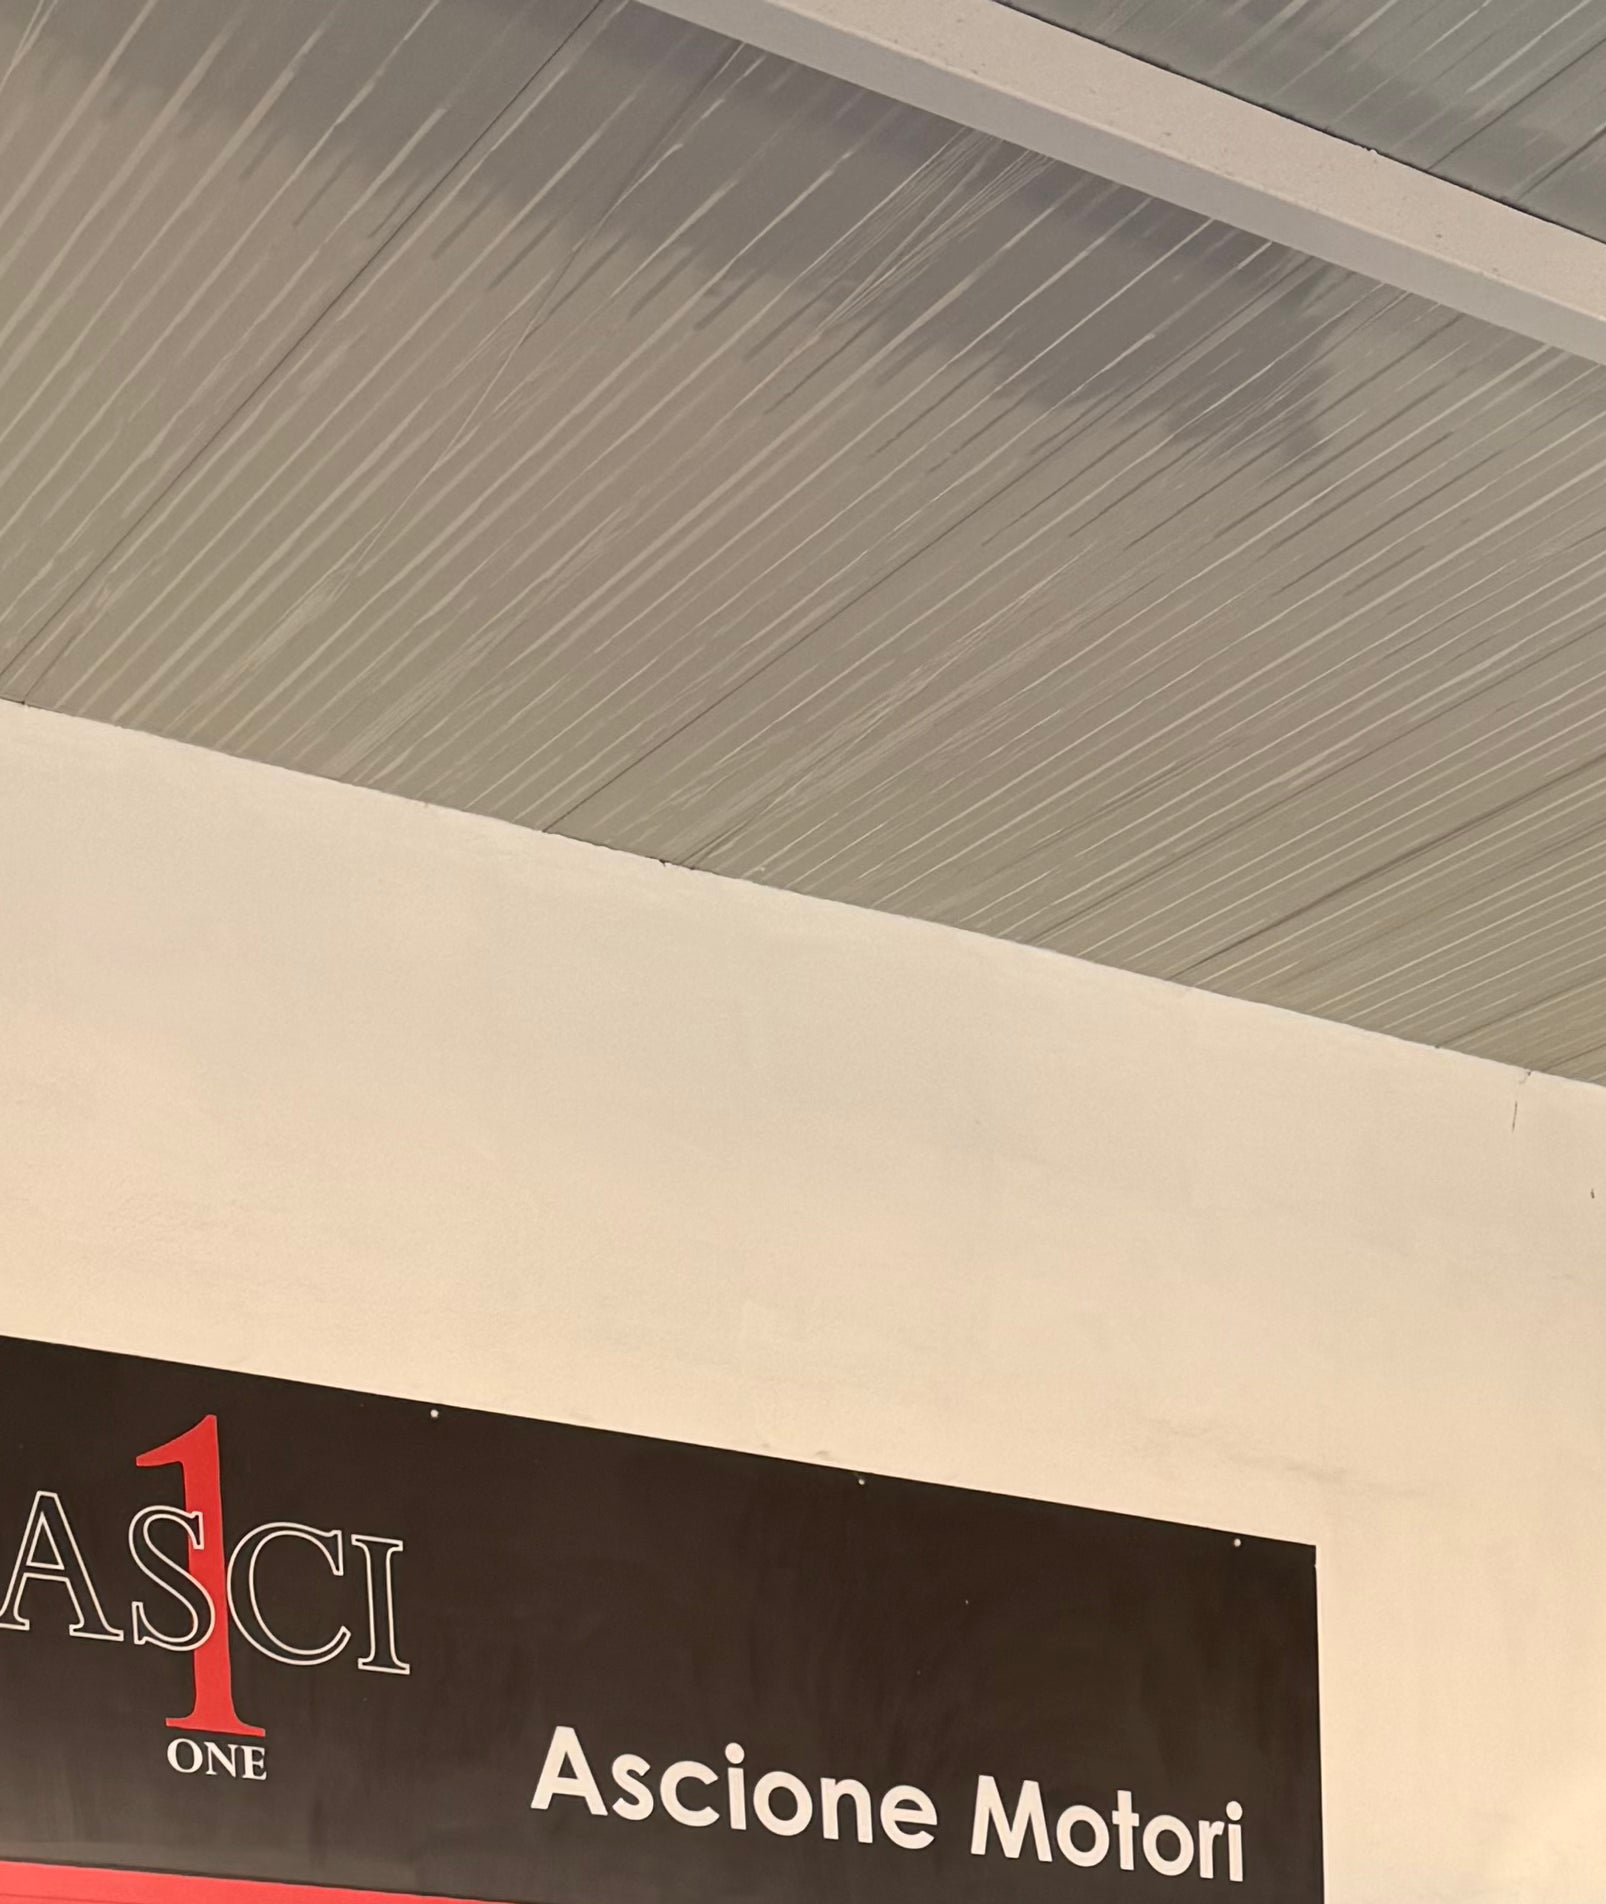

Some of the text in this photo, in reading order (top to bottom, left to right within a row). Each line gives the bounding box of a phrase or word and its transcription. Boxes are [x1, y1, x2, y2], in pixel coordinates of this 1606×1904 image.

[166, 1738, 268, 1781] ONE
[530, 1725, 1244, 1883] Ascione Motori
